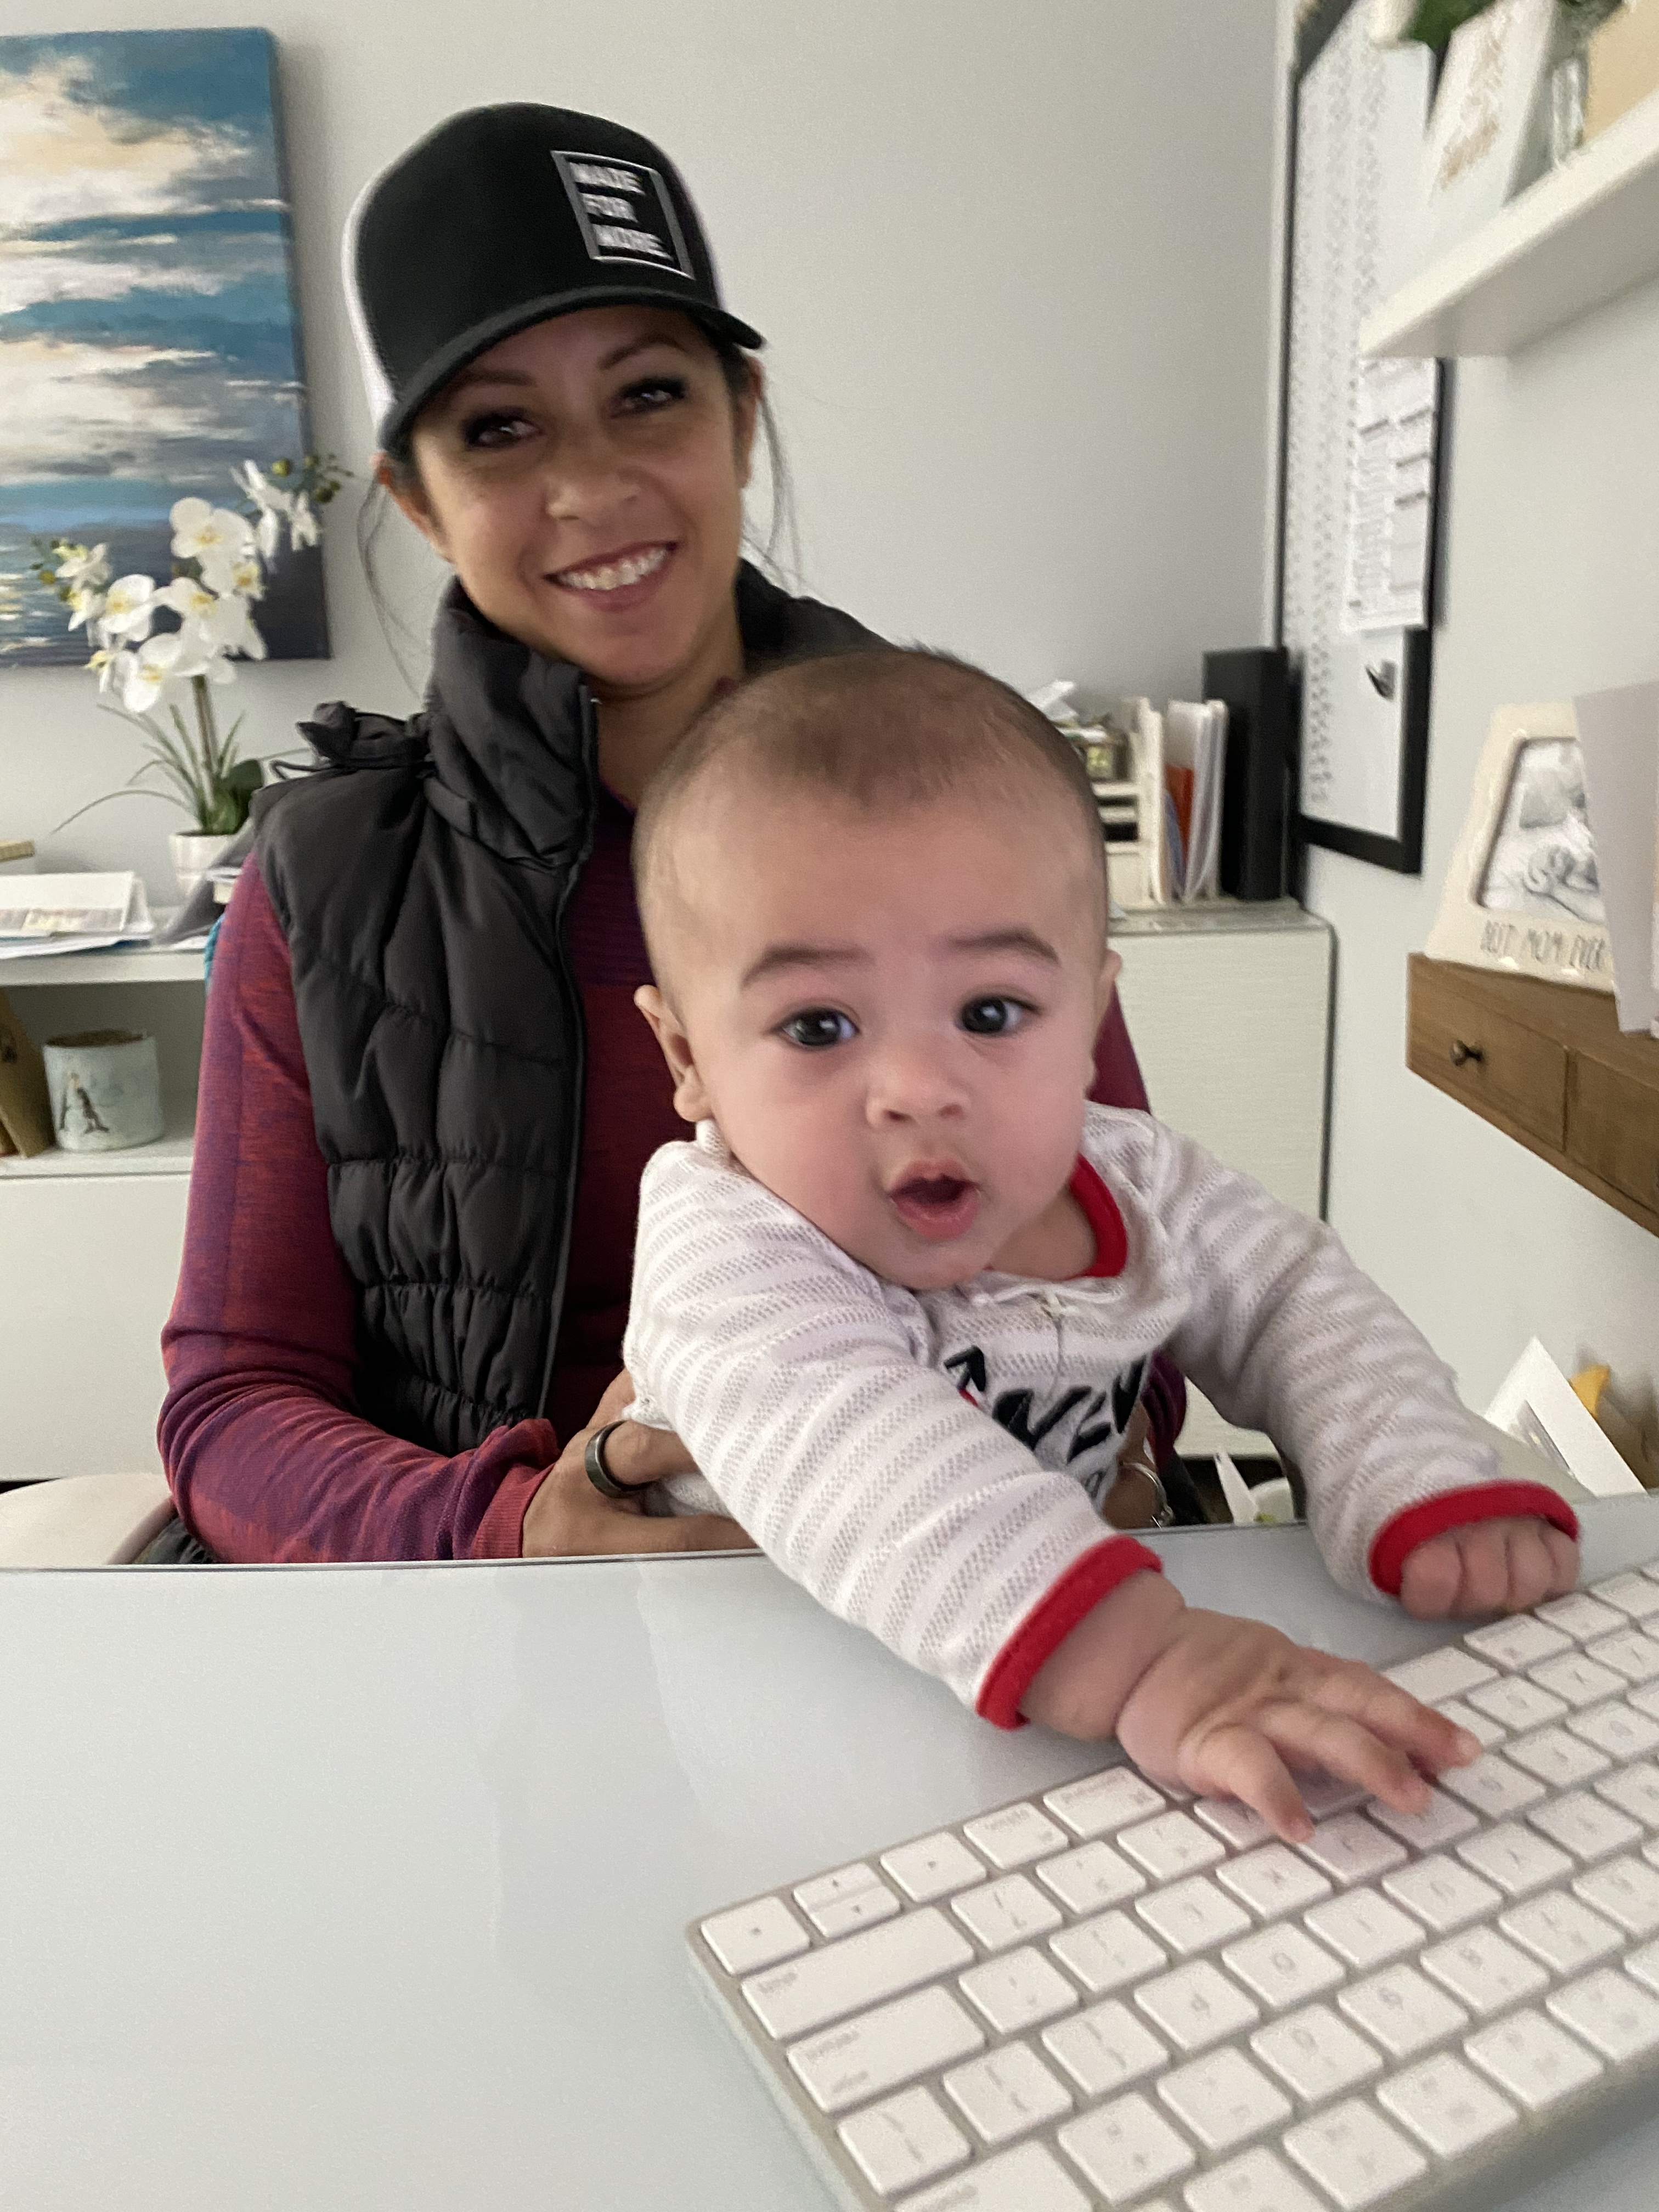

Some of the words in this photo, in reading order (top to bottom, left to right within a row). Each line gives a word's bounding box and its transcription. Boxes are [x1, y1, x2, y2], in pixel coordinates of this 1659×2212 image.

[569, 162, 646, 195] MADE
[582, 193, 639, 223] FOR
[592, 223, 674, 262] MORE
